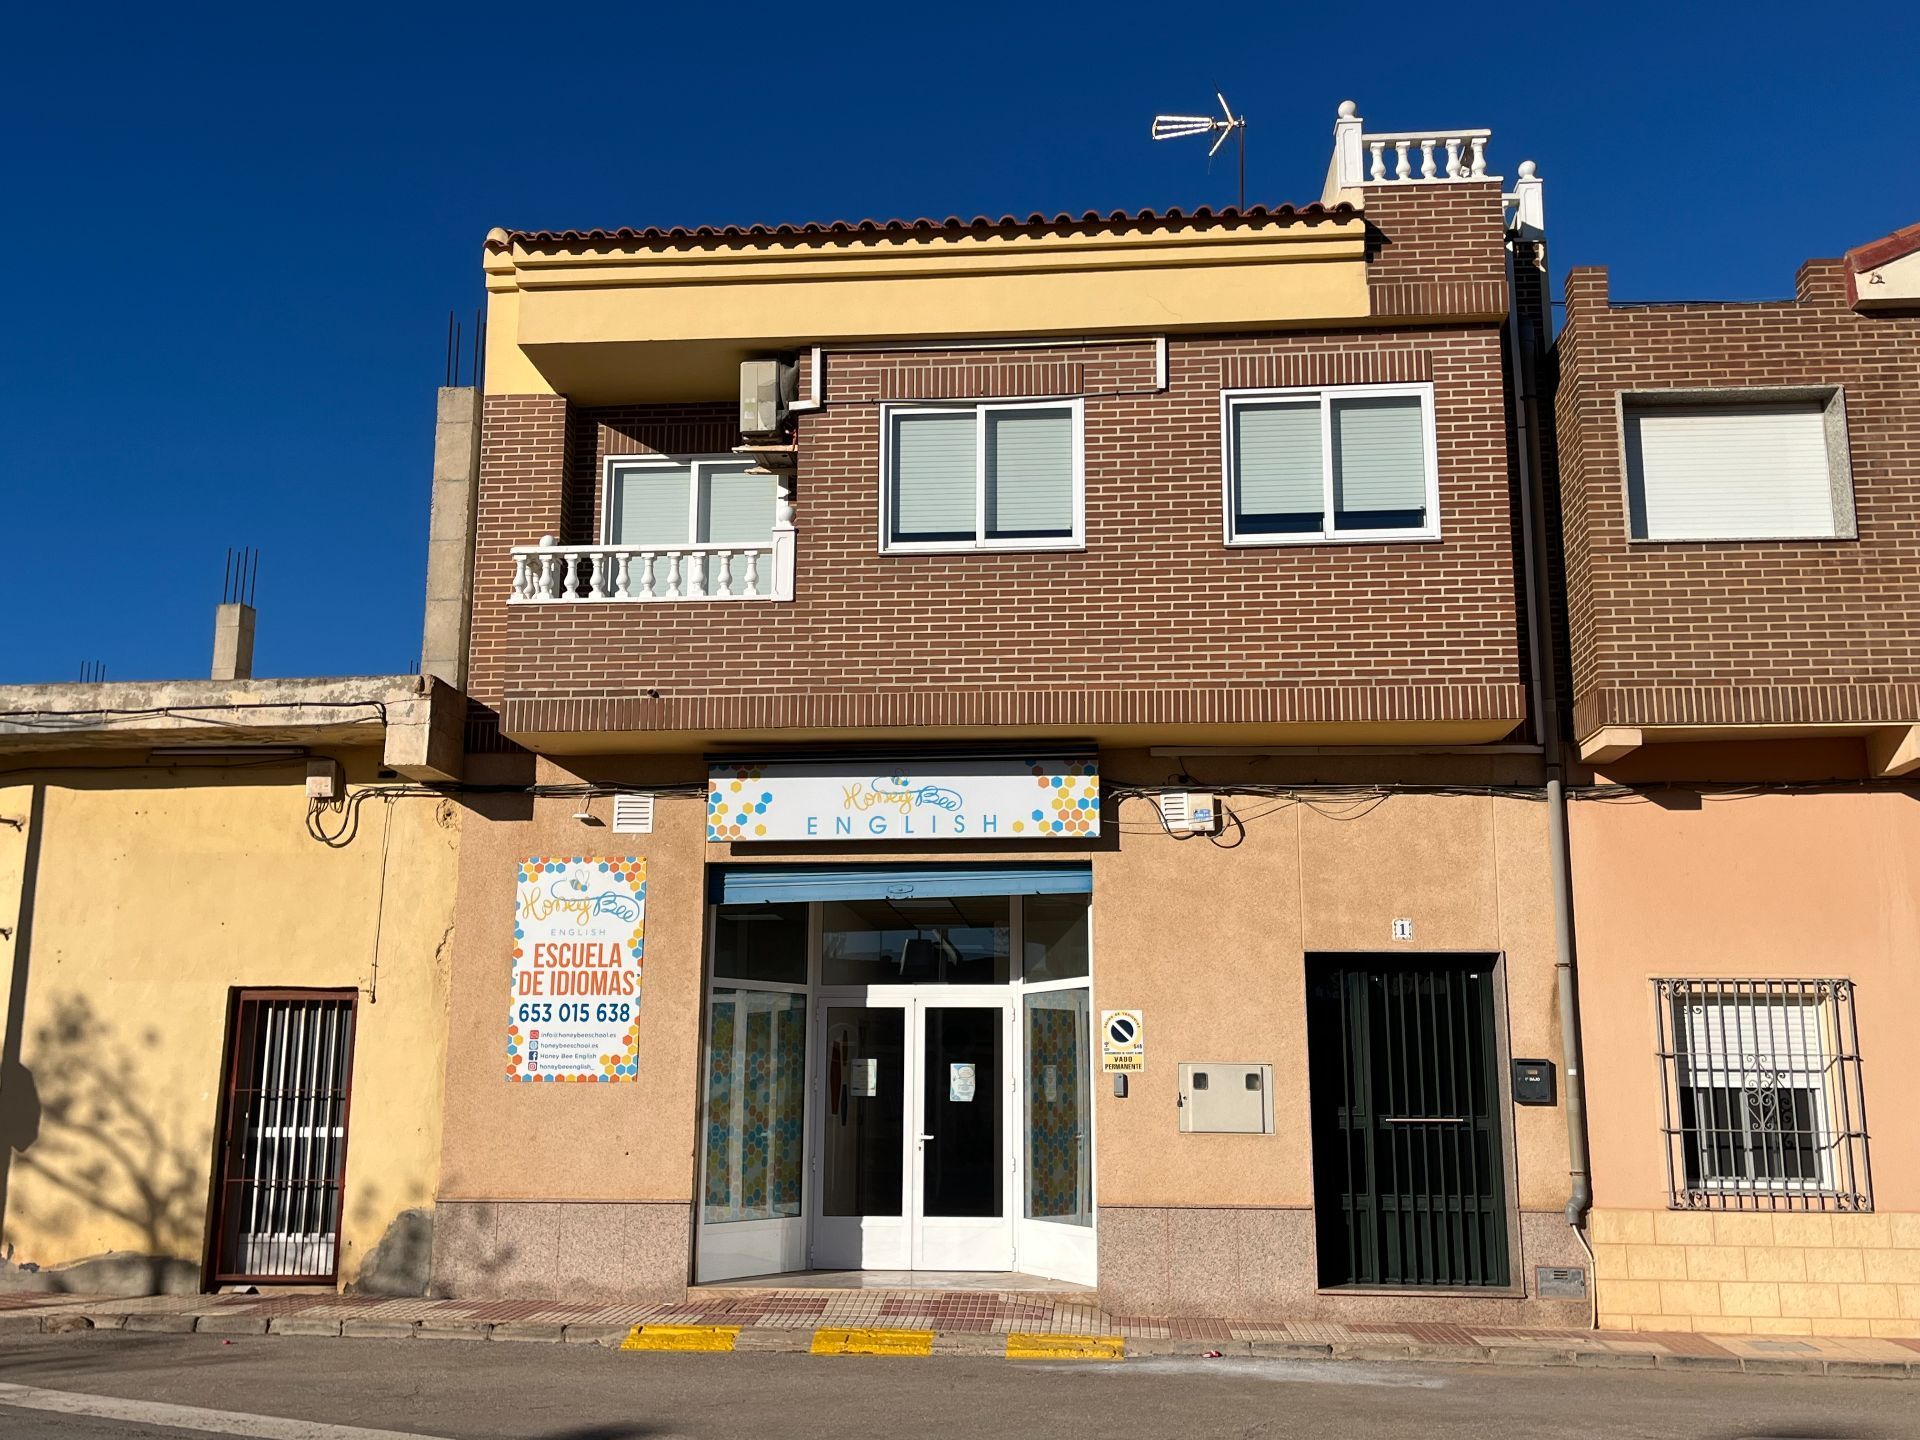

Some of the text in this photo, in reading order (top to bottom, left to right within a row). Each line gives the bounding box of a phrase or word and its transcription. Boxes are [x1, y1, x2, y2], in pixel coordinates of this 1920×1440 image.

[842, 782, 963, 814] Honey Bee
[807, 814, 997, 835] ENGLISH
[521, 885, 641, 926] Honey Bee
[550, 928, 607, 937] ENGLISH
[1400, 924, 1406, 935] 1
[533, 942, 622, 969] ESCUELA
[518, 970, 635, 996] DE IDIOMAS
[518, 1003, 630, 1023] 653 015 638
[540, 1042, 599, 1050] honeybeeschool.es
